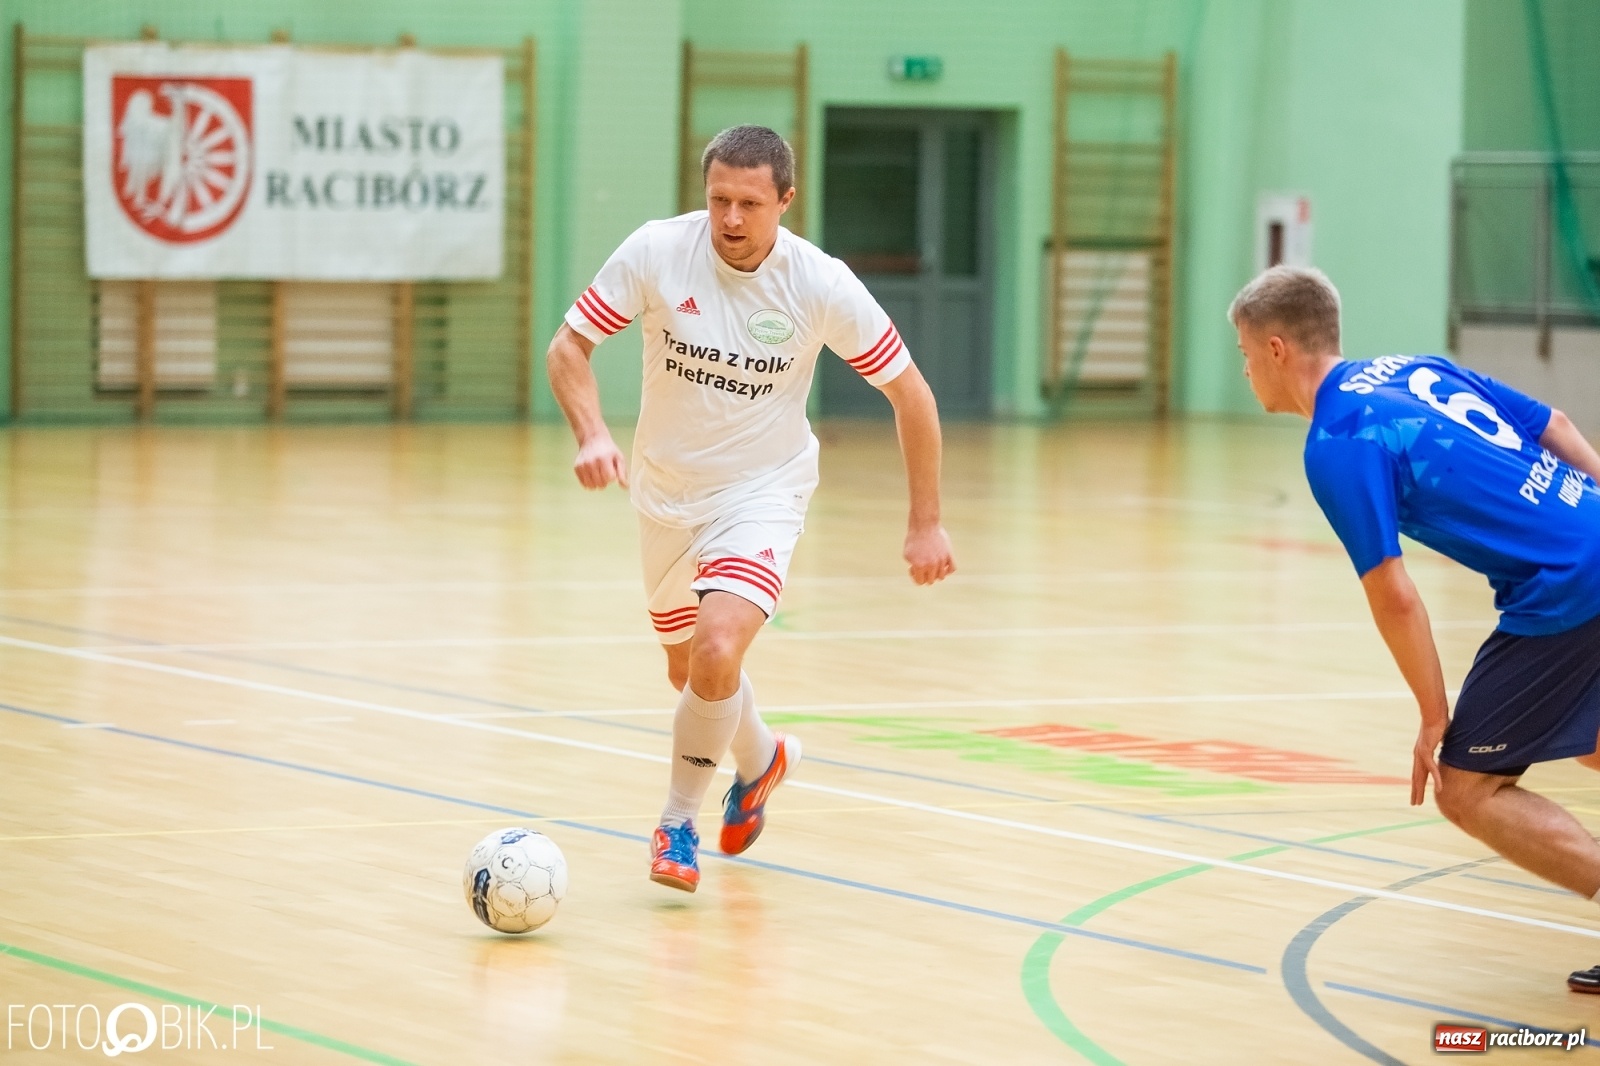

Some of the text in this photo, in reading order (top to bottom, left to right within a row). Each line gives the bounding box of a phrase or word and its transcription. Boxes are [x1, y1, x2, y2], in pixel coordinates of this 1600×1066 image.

[292, 115, 460, 154] MIASTO
[265, 163, 489, 211] RACIBÓRZ
[662, 329, 794, 374] Trawa z rolki
[665, 358, 774, 400] Pietraszyn
[1408, 366, 1522, 451] 6
[1469, 743, 1507, 753] COLO
